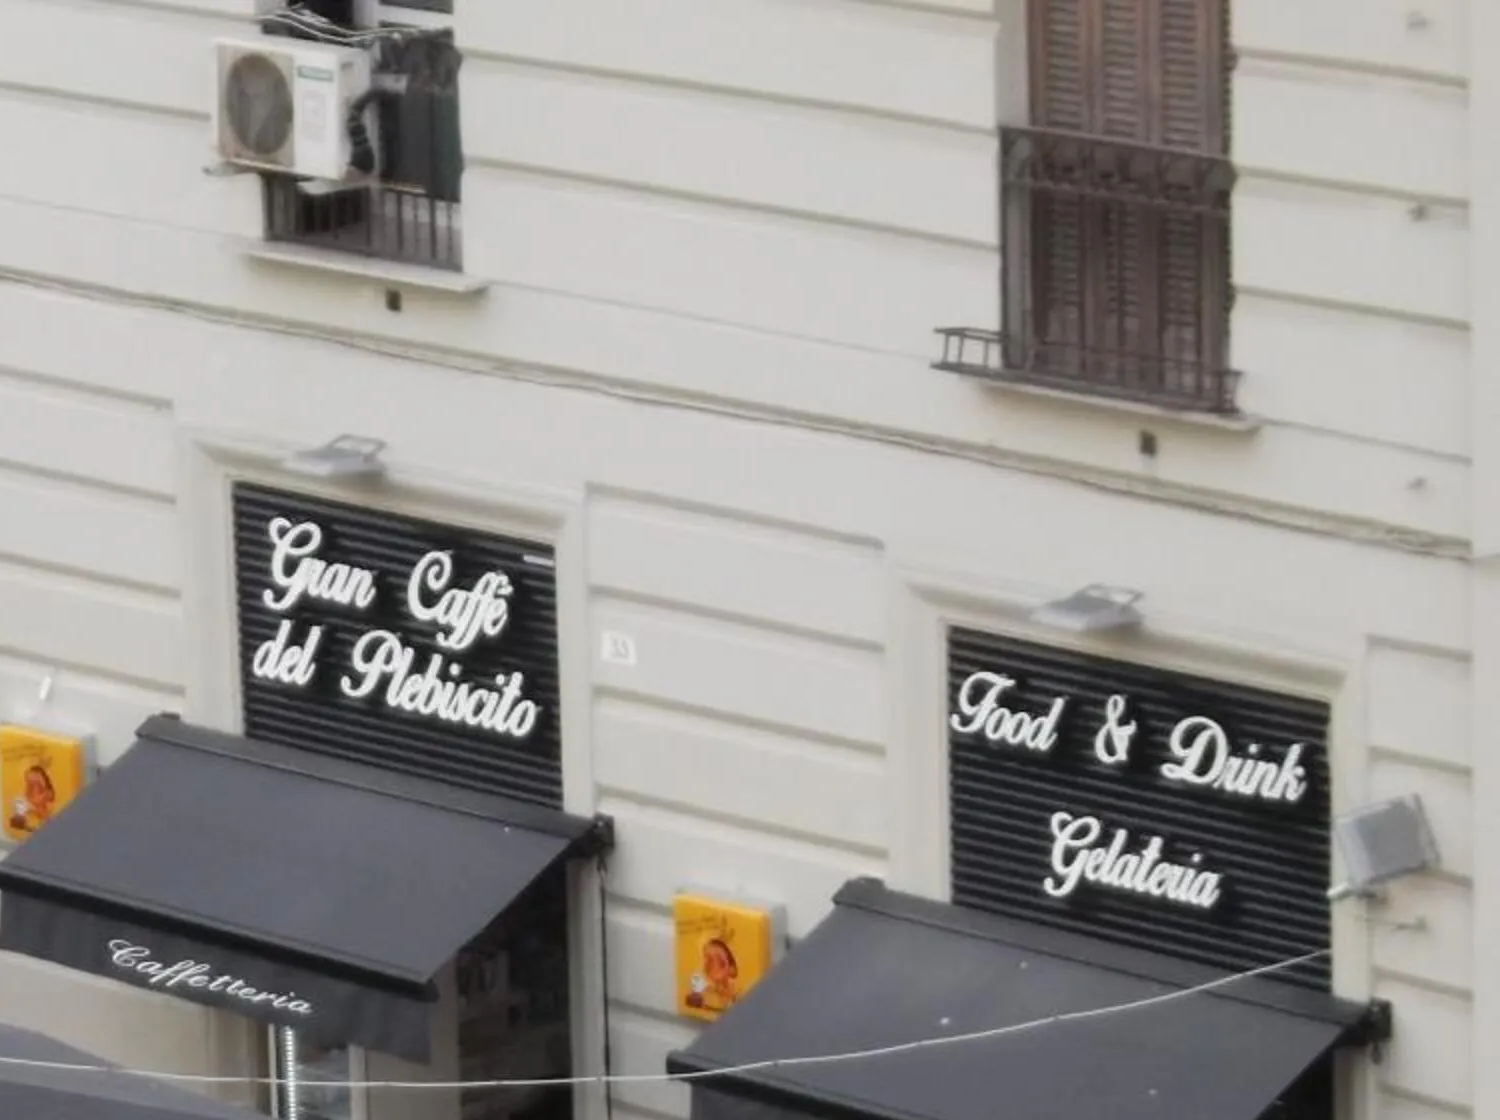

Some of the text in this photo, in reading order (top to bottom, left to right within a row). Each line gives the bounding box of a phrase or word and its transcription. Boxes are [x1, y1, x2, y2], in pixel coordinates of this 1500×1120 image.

[263, 517, 376, 610] Gran
[252, 620, 538, 737] del Plebiscito
[950, 671, 1307, 802] Food & Drink
[1044, 811, 1221, 909] Gelateria
[107, 938, 313, 1016] Caffetteria
